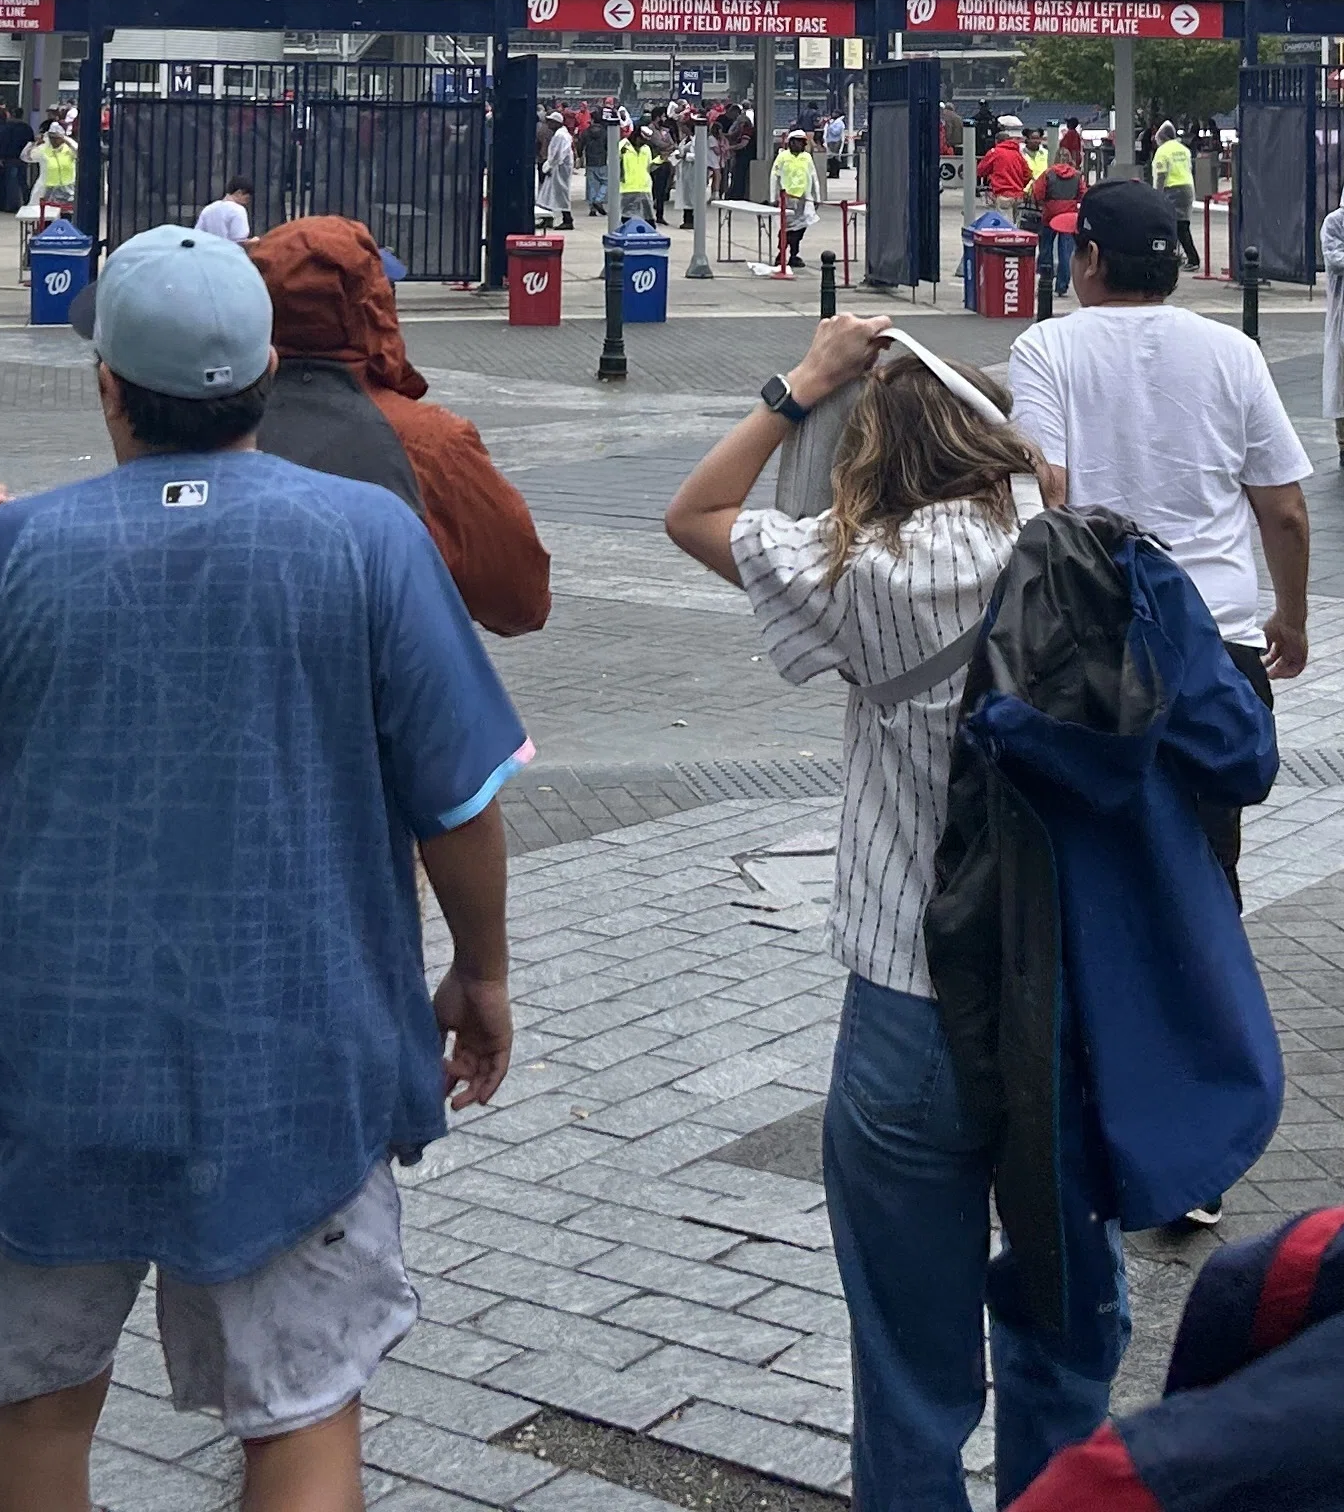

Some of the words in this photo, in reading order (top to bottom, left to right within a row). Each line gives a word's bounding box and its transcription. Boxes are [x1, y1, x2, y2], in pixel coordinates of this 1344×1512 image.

[7, 7, 26, 17] LINE
[722, 0, 761, 16] GATES
[764, 0, 780, 16] AT
[1034, 0, 1073, 17] GATES
[1076, 1, 1091, 17] AT
[1094, 2, 1123, 18] LEFT
[1126, 3, 1165, 20] FIELD,
[17, 19, 40, 29] ITEMS
[641, 14, 681, 31] RIGHT
[684, 15, 721, 32] FIELD
[725, 16, 751, 32] AND
[755, 16, 792, 33] FIRST
[795, 17, 827, 33] BASE
[957, 15, 995, 31] THIRD
[999, 15, 1030, 32] BASE
[1034, 16, 1058, 32] AND
[1062, 17, 1098, 33] HOME
[1101, 18, 1138, 35] PLATE
[175, 76, 192, 92] M
[682, 82, 700, 96] XL
[516, 240, 536, 248] TRASH
[1004, 257, 1019, 315] TRASH
